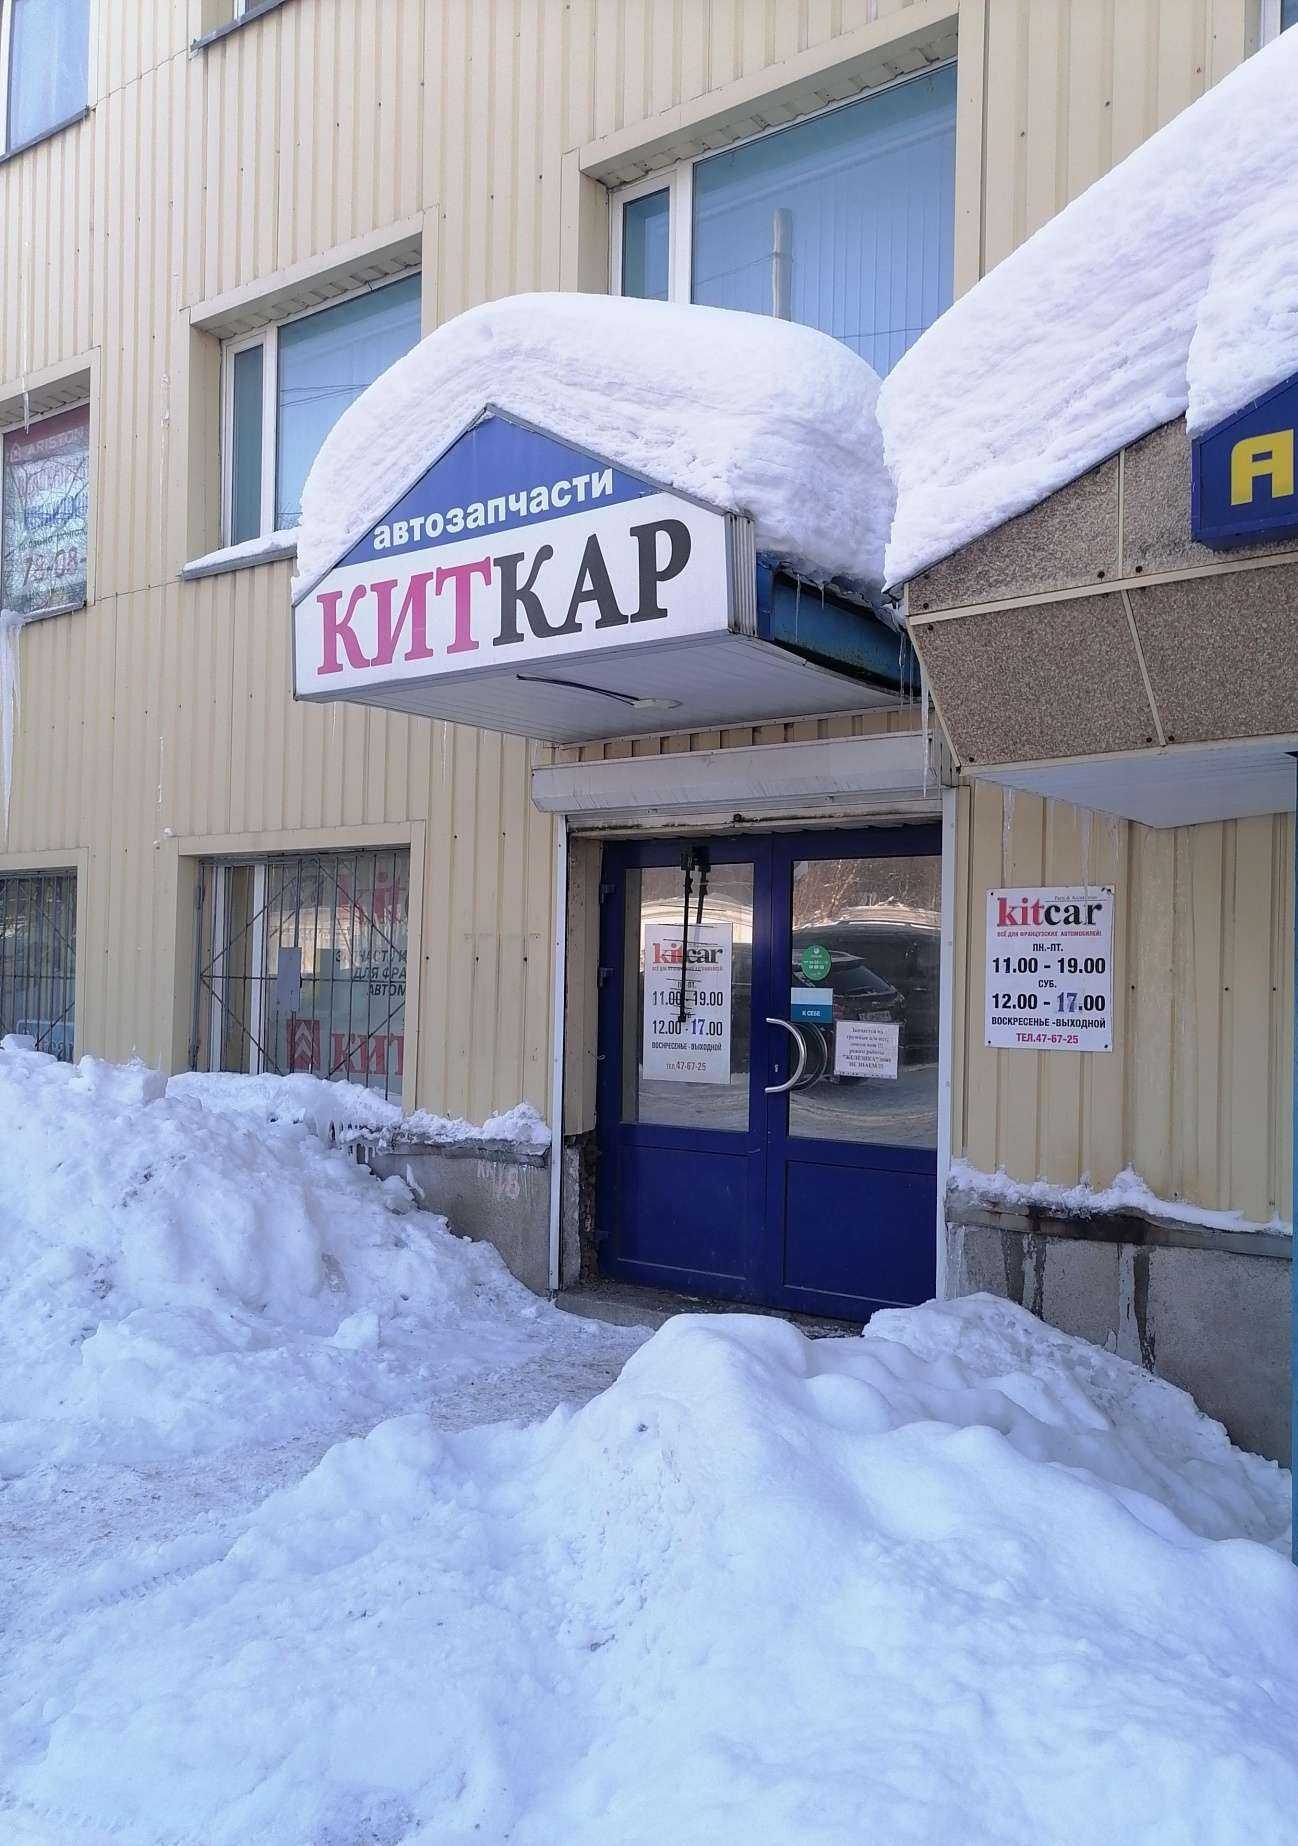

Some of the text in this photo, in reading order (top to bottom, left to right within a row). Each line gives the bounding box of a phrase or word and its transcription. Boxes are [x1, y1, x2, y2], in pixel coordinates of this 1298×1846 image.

[373, 468, 613, 550] автозапчасти
[317, 518, 692, 676] КИТКАР
[336, 870, 408, 926] kit
[997, 897, 1102, 927] kitcar
[992, 957, 1038, 973] 11.00
[1057, 957, 1106, 974] 19.00
[652, 991, 682, 1006] 11.00
[693, 991, 723, 1006] 19.00
[992, 993, 1038, 1009] 12.00
[1057, 992, 1106, 1012] 17.00
[652, 1020, 682, 1035] 12.00
[691, 1019, 723, 1036] 17.00
[992, 1017, 1050, 1026] ВОСКРЕСЕНЬЕ
